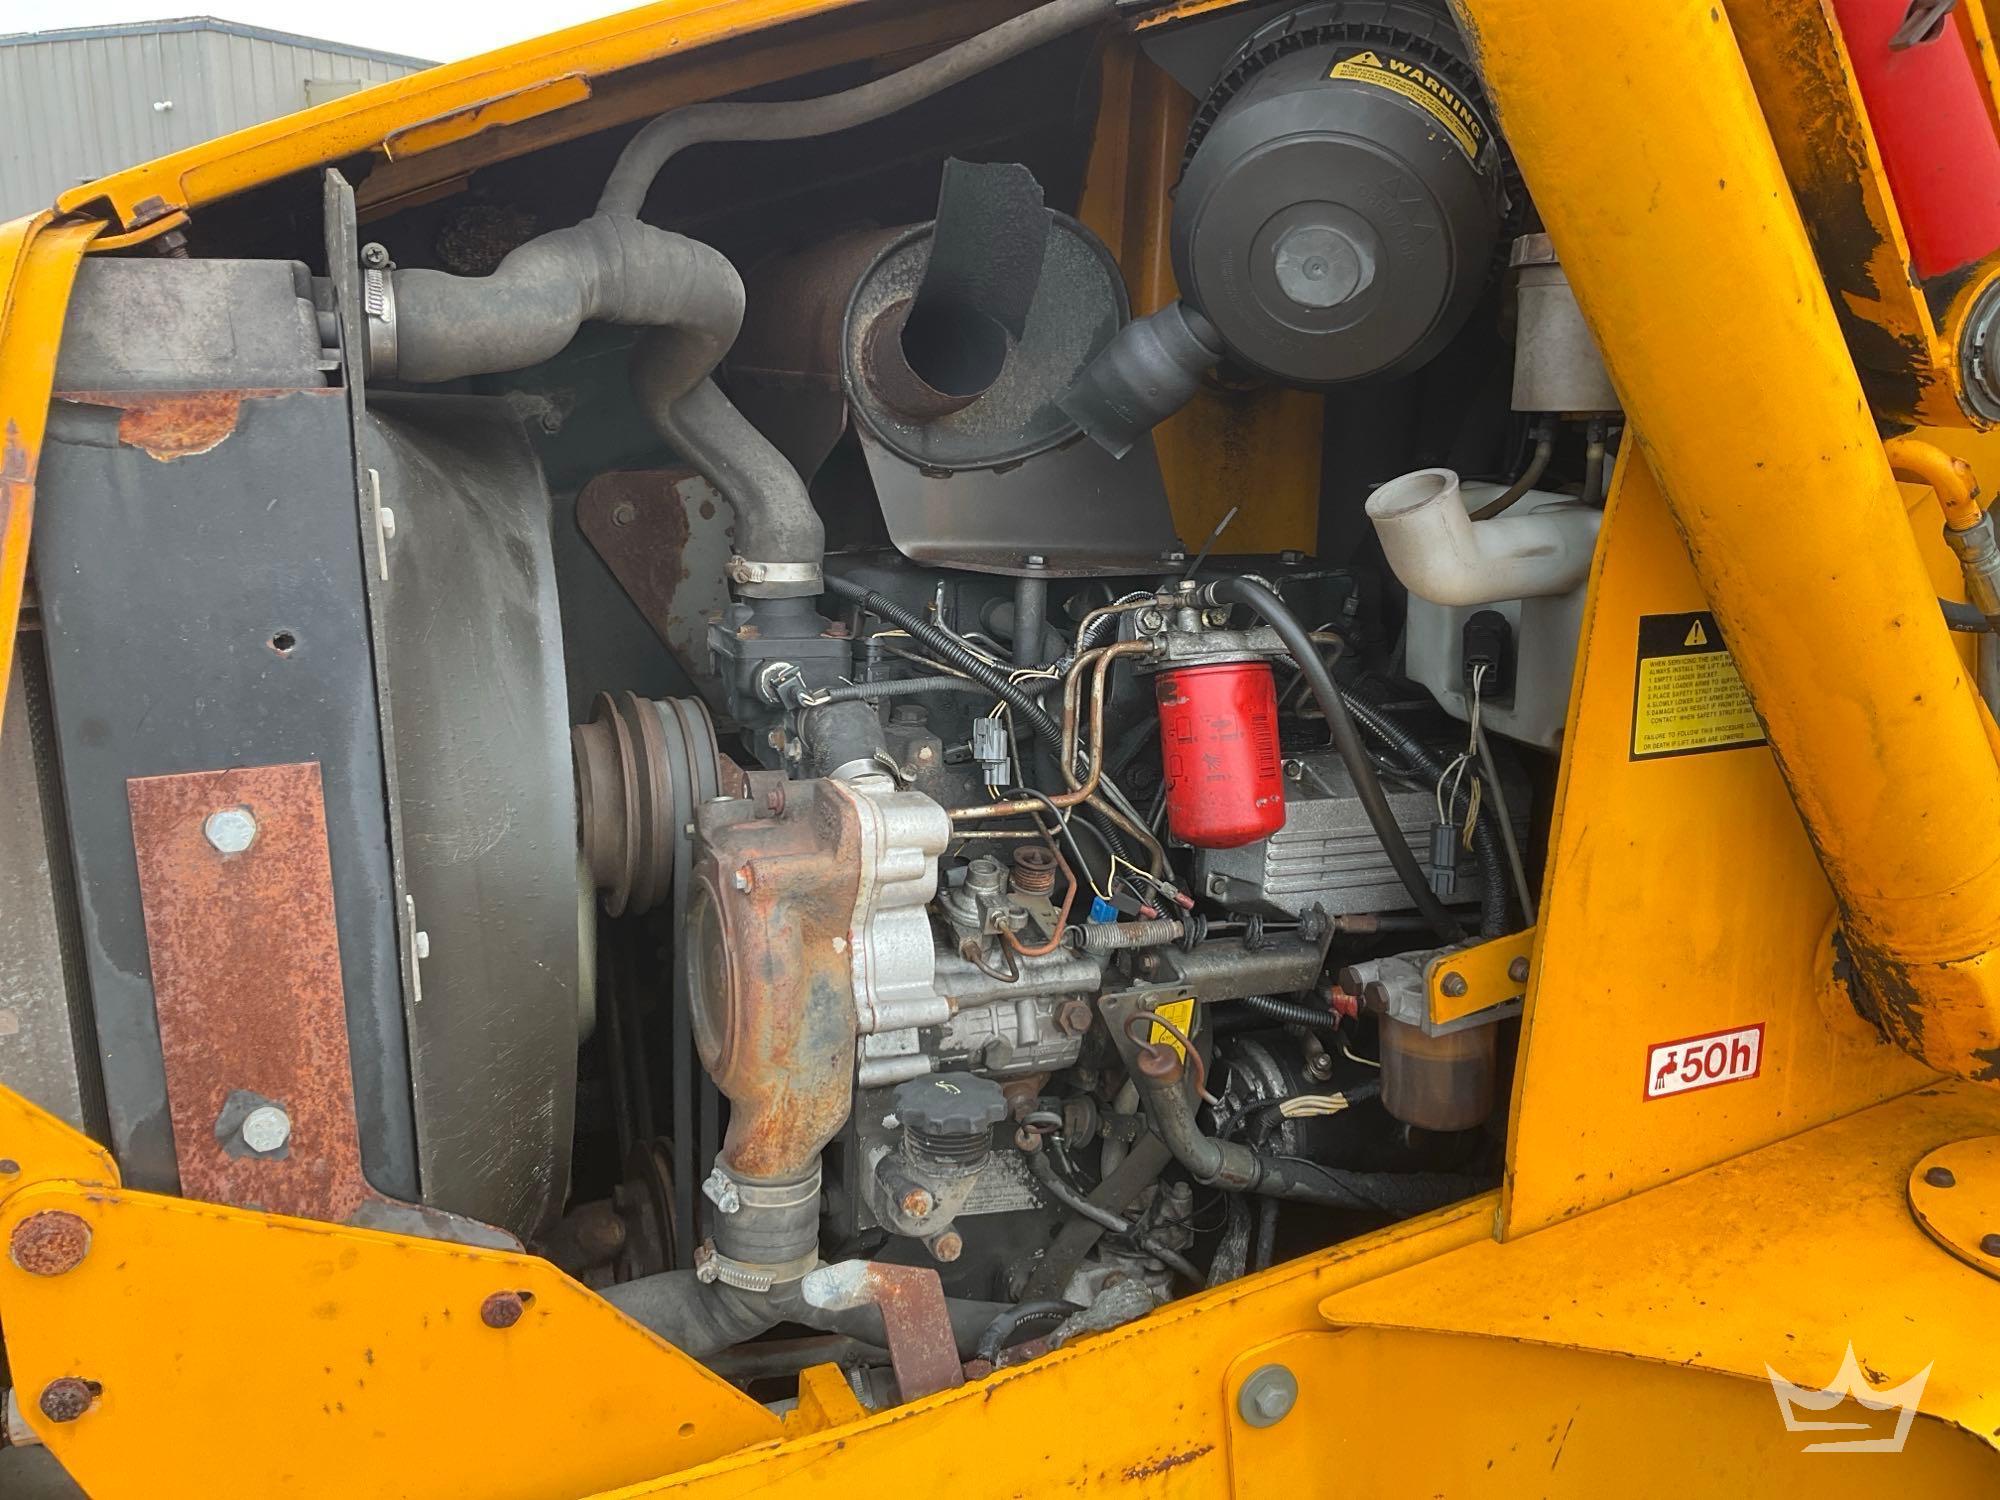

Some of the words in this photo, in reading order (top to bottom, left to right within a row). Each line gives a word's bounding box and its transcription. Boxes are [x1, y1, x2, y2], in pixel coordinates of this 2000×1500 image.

[1389, 59, 1482, 138] WARNING
[1644, 732, 1666, 740] FAILURE
[1715, 723, 1744, 732] PROCEDURE
[1650, 716, 1677, 724] CONTACT
[1681, 1038, 1751, 1083] 50h
